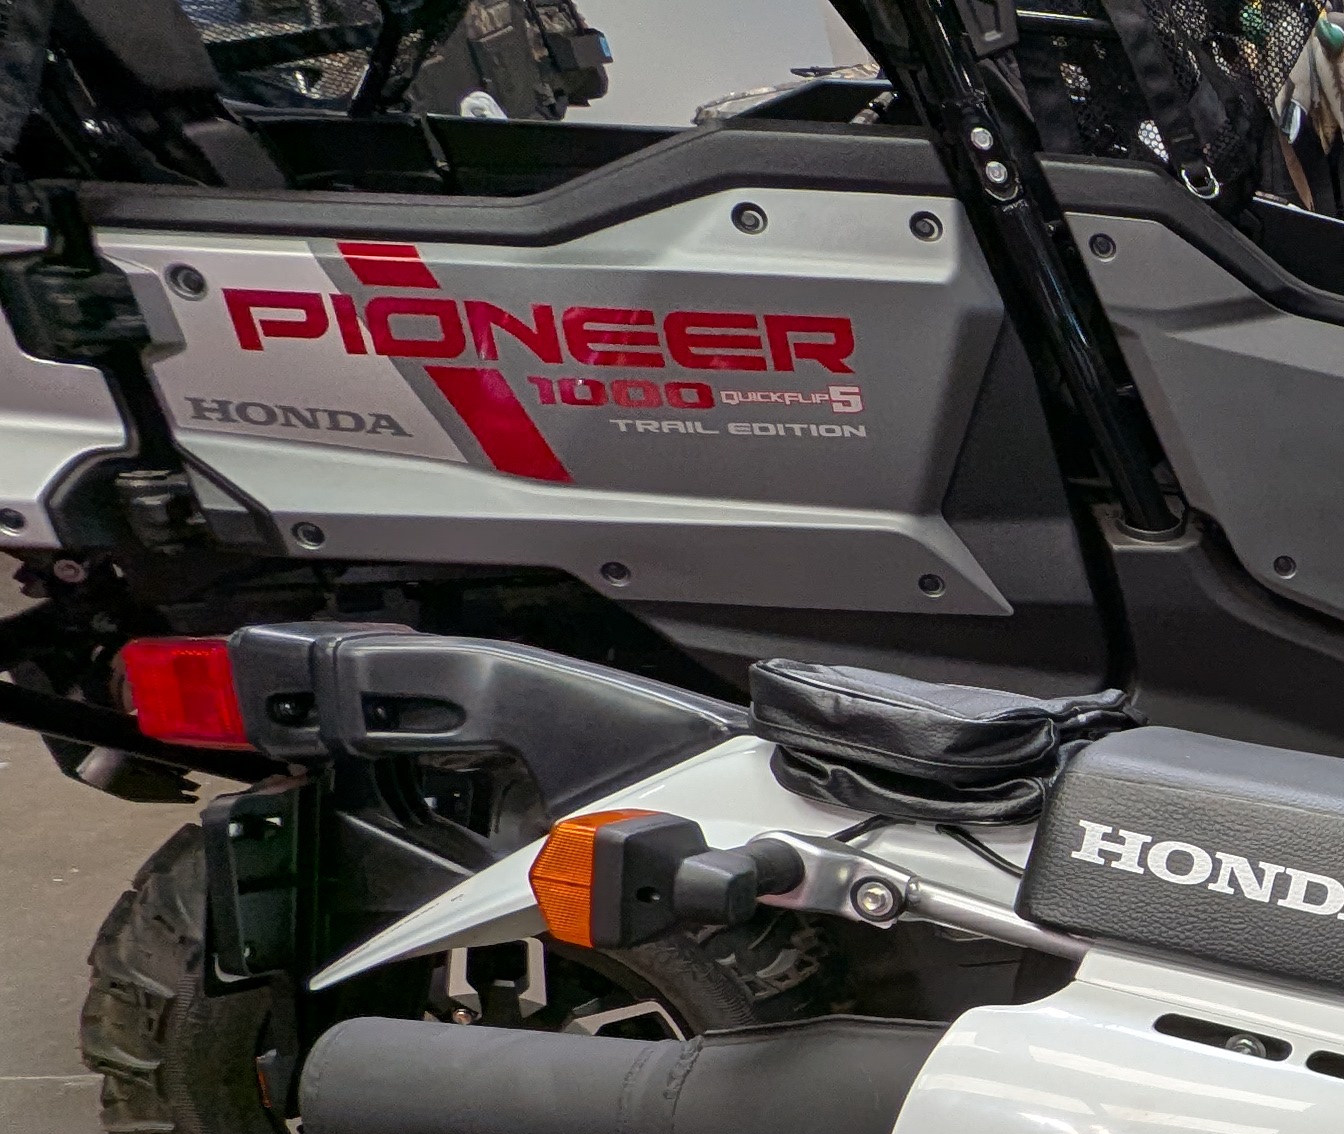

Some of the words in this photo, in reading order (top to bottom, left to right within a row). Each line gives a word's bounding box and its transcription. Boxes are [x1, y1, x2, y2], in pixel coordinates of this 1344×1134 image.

[222, 288, 856, 374] PIONEER
[527, 375, 716, 409] 1000
[184, 396, 413, 438] HONDA
[609, 419, 720, 435] TRAIL
[727, 421, 868, 438] EDITION
